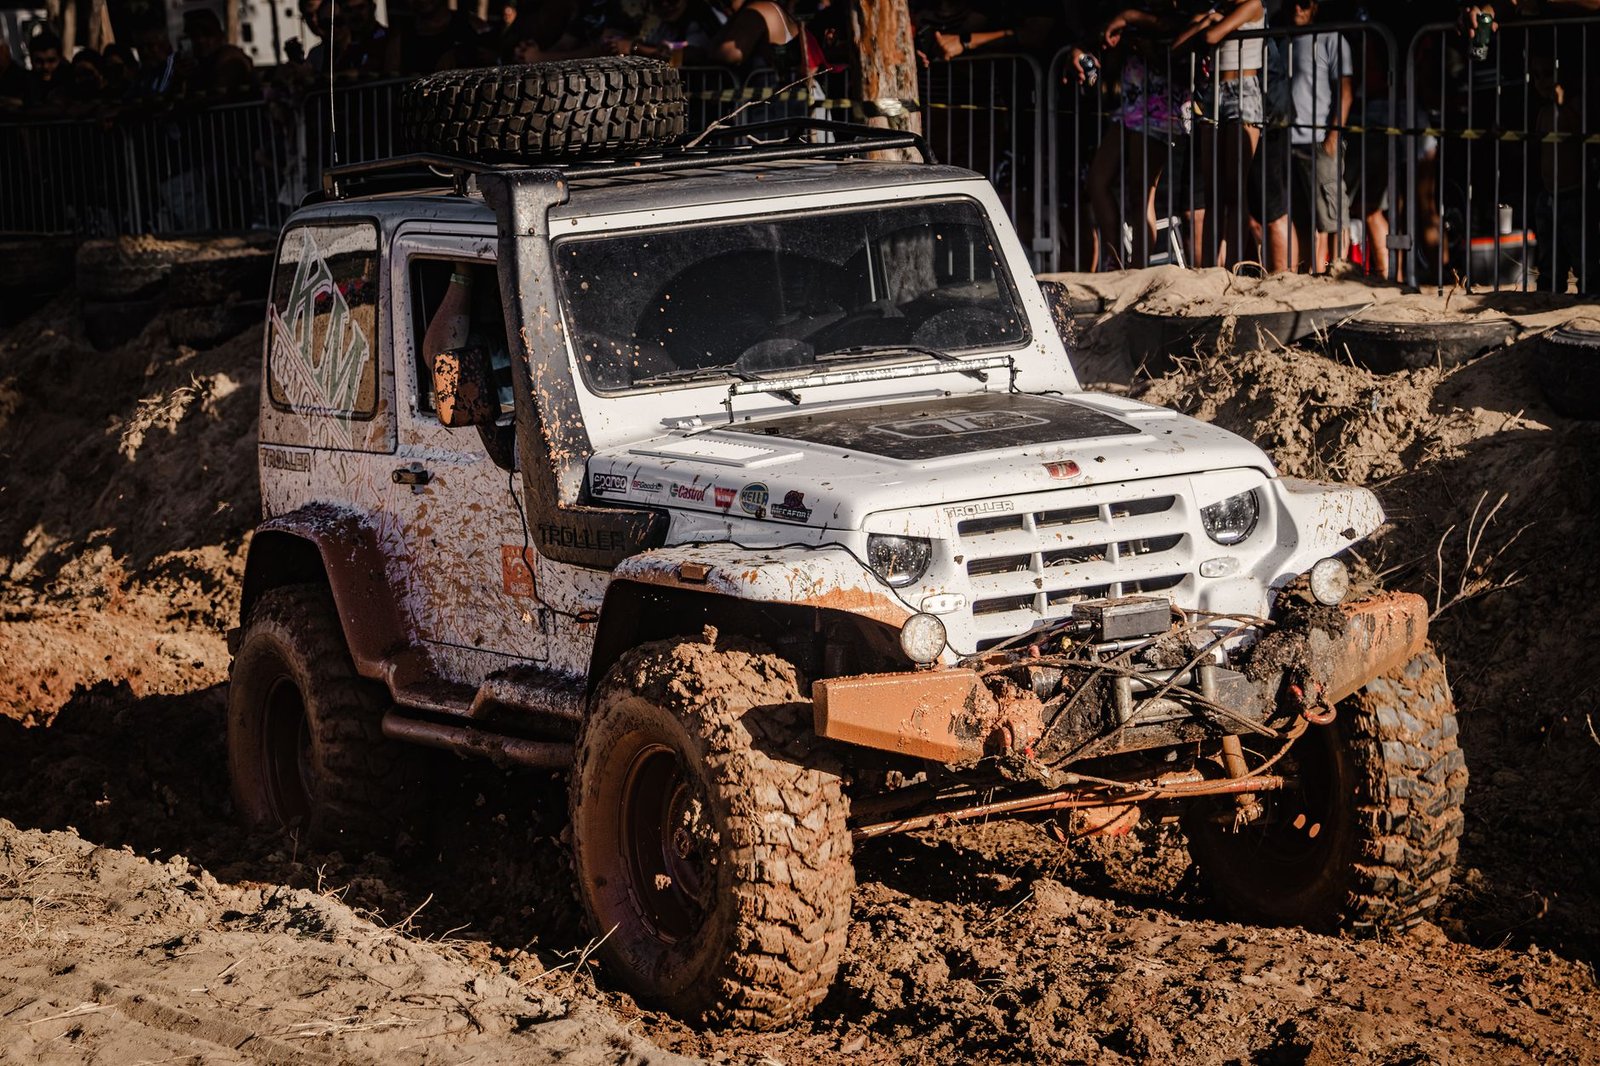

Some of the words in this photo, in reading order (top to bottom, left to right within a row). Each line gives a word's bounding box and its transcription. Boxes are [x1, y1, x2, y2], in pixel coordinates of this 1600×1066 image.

[260, 447, 310, 472] TROLLER
[678, 485, 705, 501] Castrol
[742, 491, 769, 506] HELLA
[943, 500, 1014, 517] TROLLER
[538, 523, 626, 551] TROLLER
